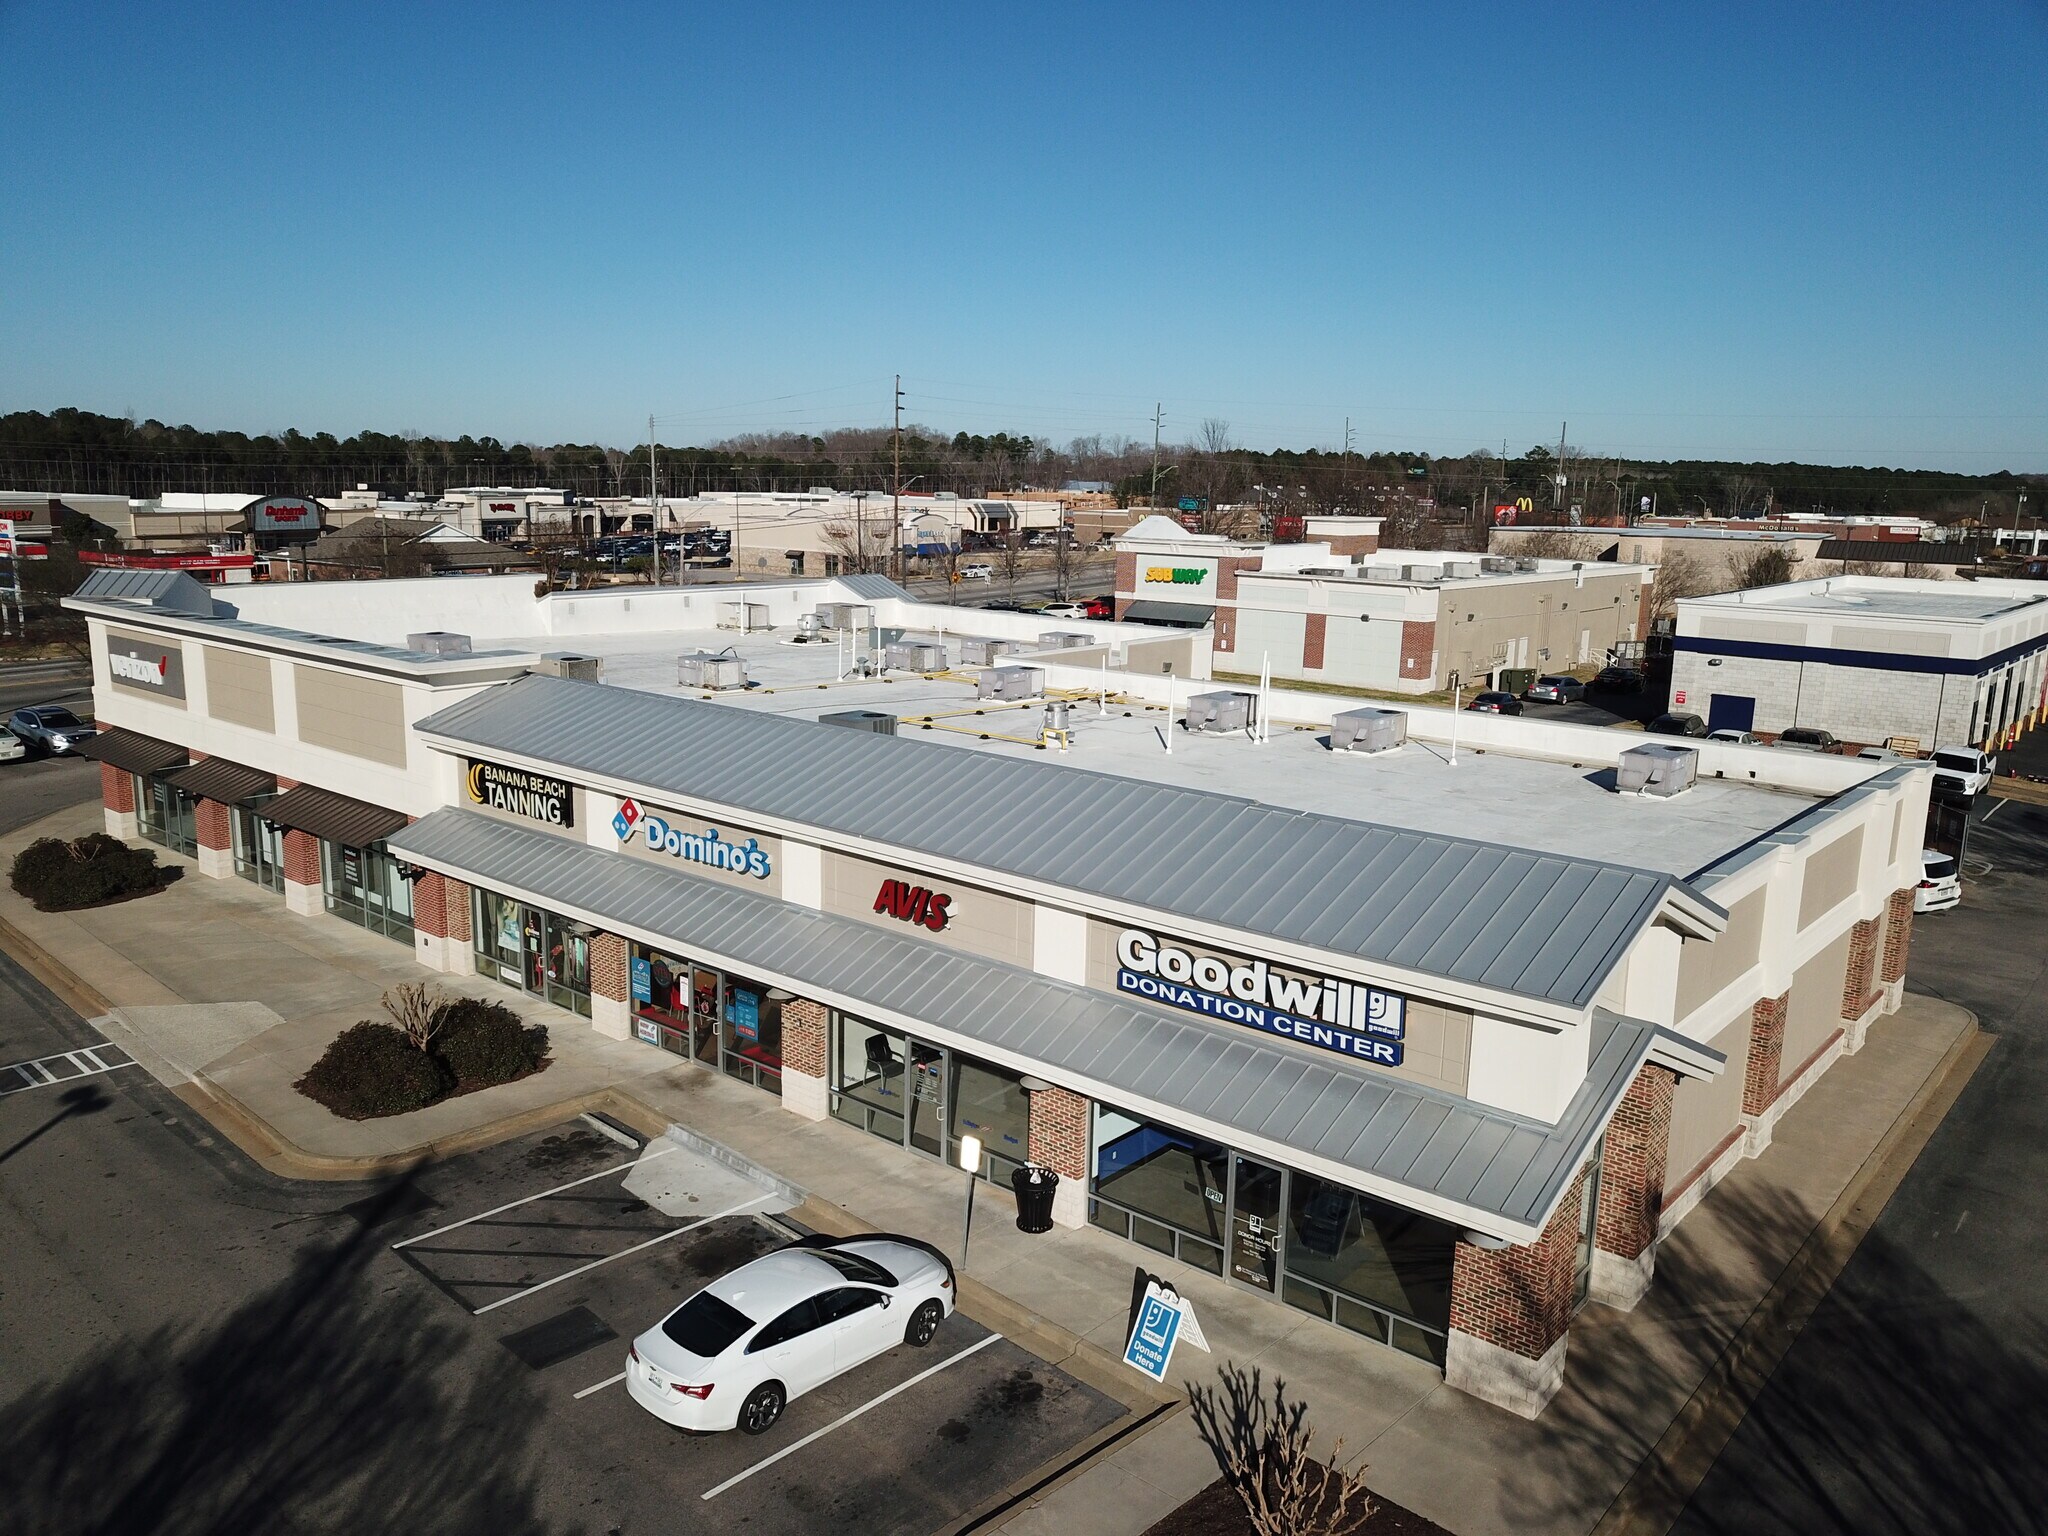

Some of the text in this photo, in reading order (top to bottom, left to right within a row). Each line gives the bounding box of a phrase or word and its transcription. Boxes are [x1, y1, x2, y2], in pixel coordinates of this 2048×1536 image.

[1145, 567, 1208, 585] SUBWAY
[109, 652, 164, 685] verizon
[485, 765, 566, 799] BANANA BEACH
[485, 782, 561, 823] TANNING
[644, 816, 771, 879] Domino's
[873, 879, 952, 932] AVIS
[1117, 929, 1368, 1032] Goodwill
[1122, 972, 1395, 1062] DONATION CENTER
[1206, 1188, 1222, 1202] OPEN
[1237, 1230, 1254, 1240] DONOR
[1134, 1340, 1163, 1362] Donate
[1135, 1353, 1155, 1370] Here
